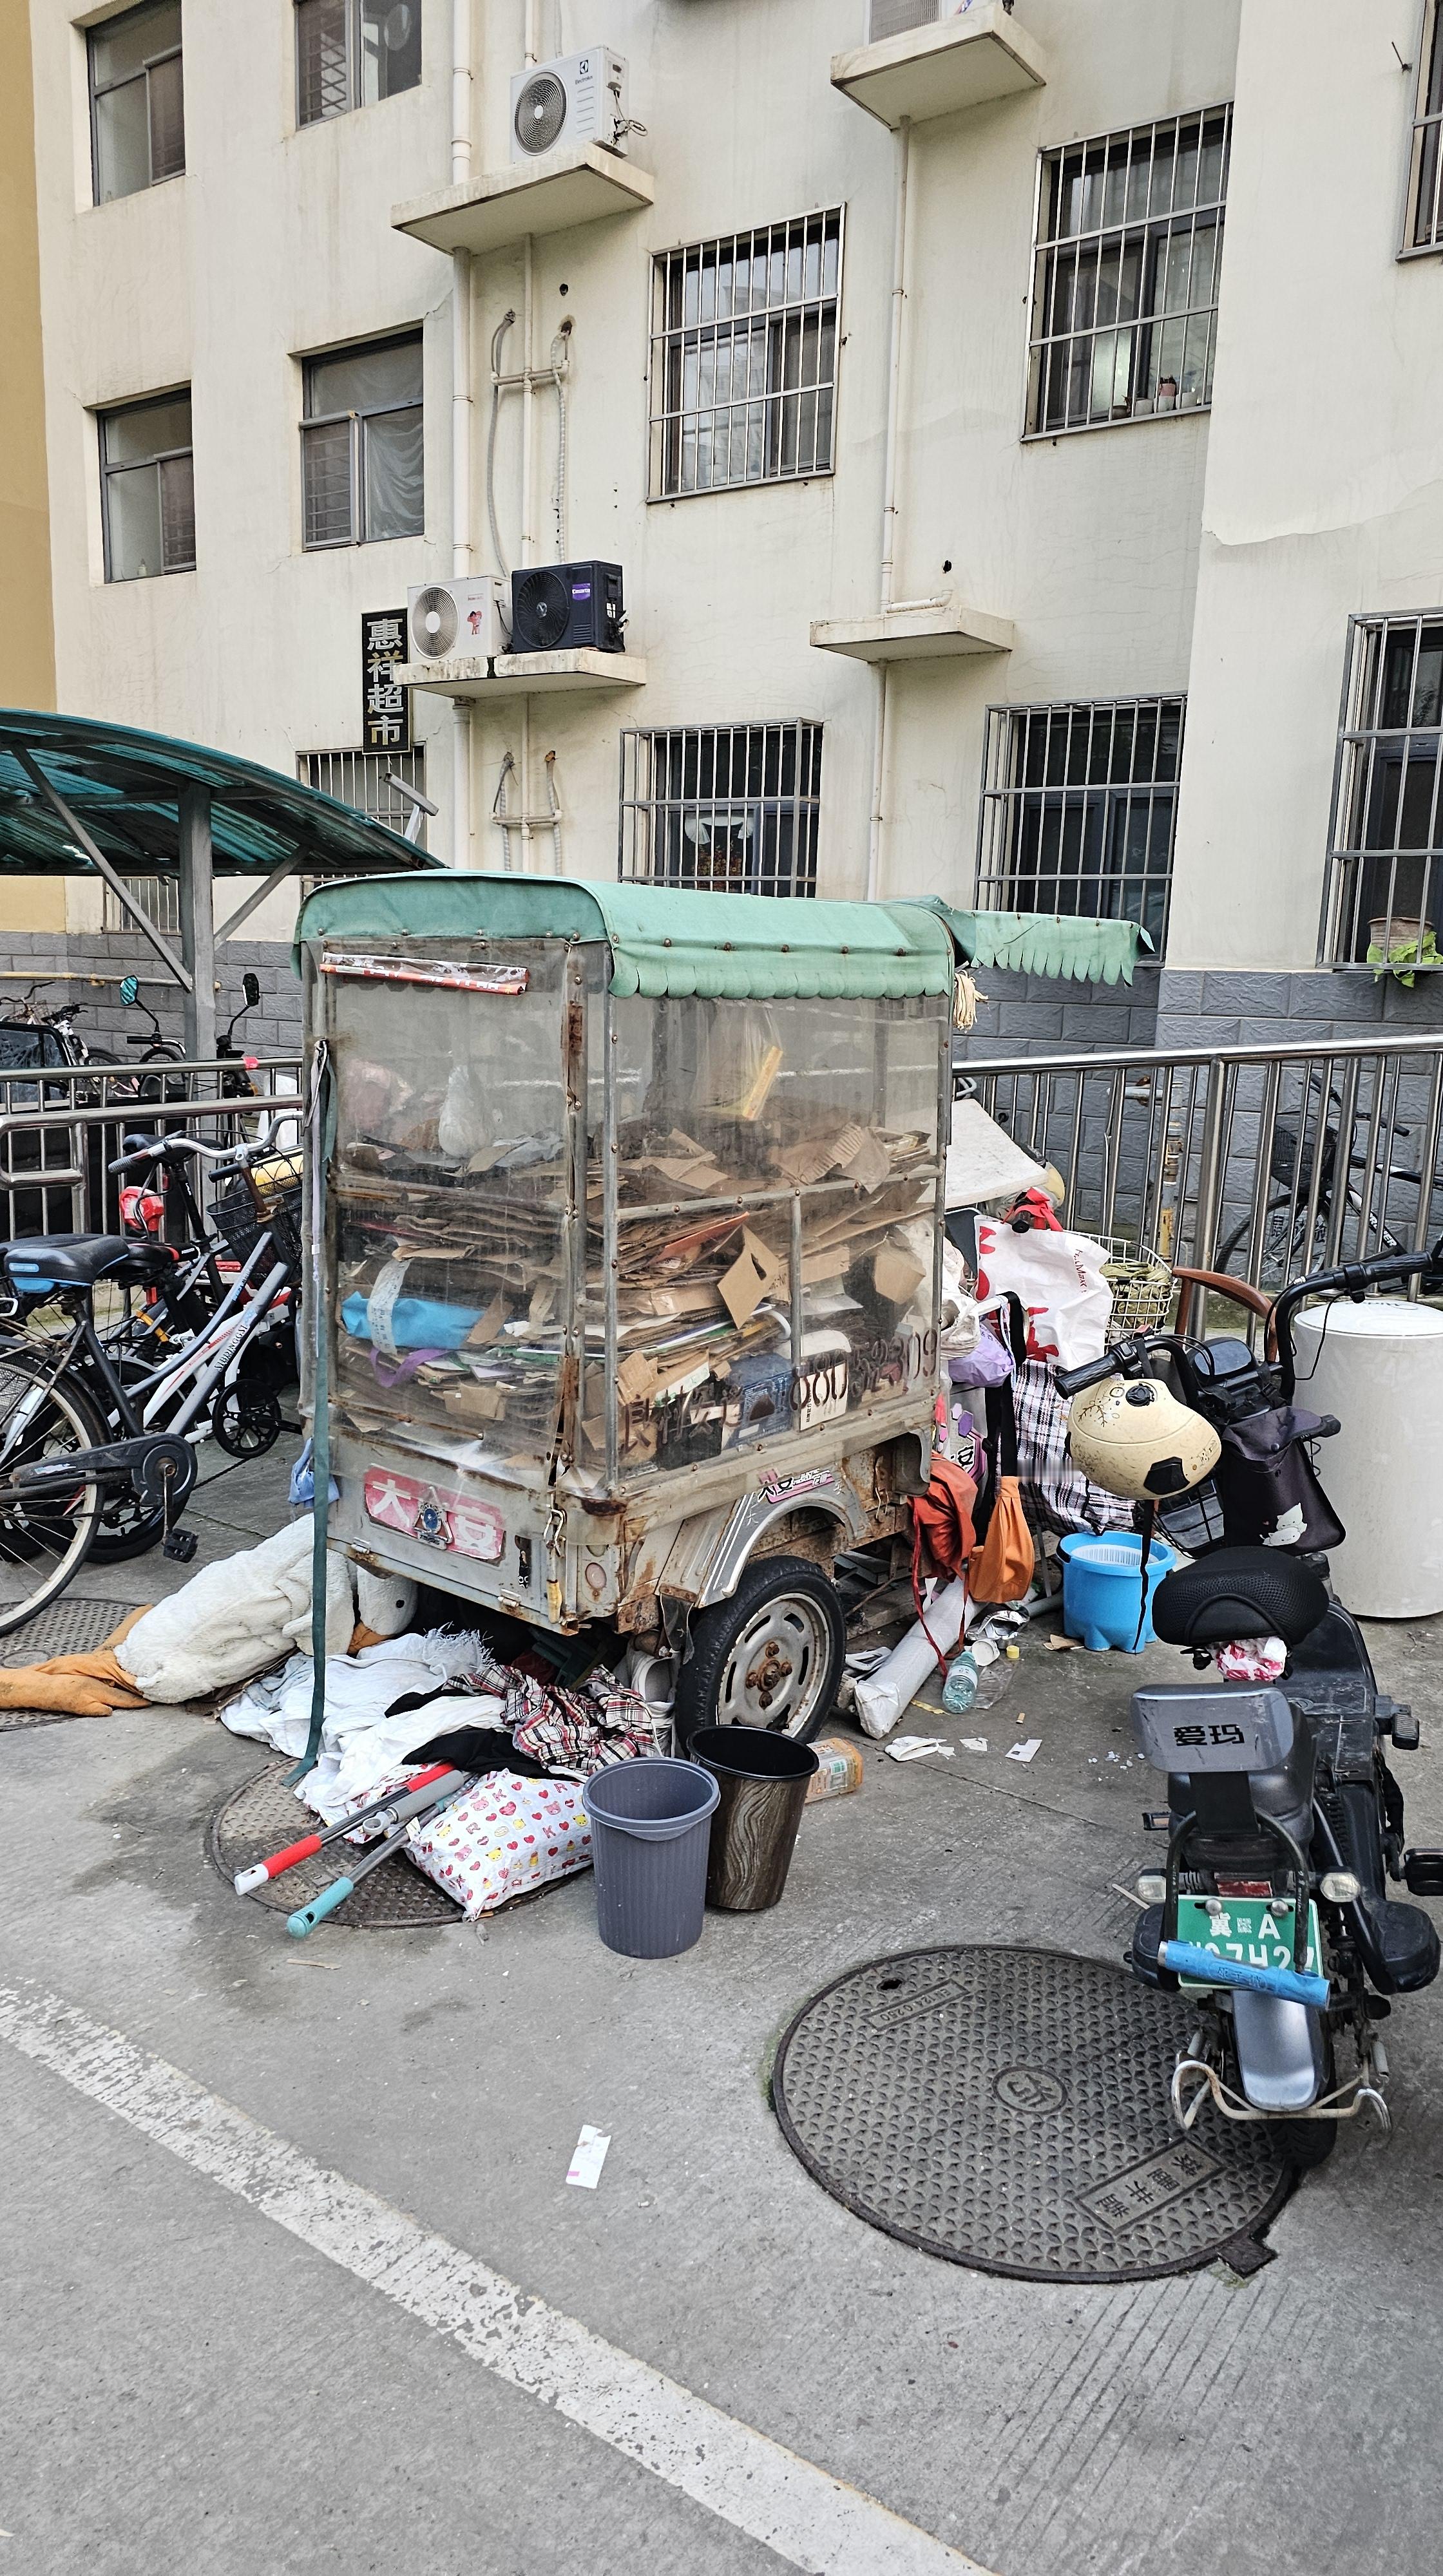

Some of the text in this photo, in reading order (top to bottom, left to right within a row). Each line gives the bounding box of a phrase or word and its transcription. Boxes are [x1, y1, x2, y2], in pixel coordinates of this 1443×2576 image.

[366, 617, 405, 746] 惠祥超市
[1173, 1723, 1245, 1747] 爱玛
[1209, 1911, 1281, 1940] 冀 A
